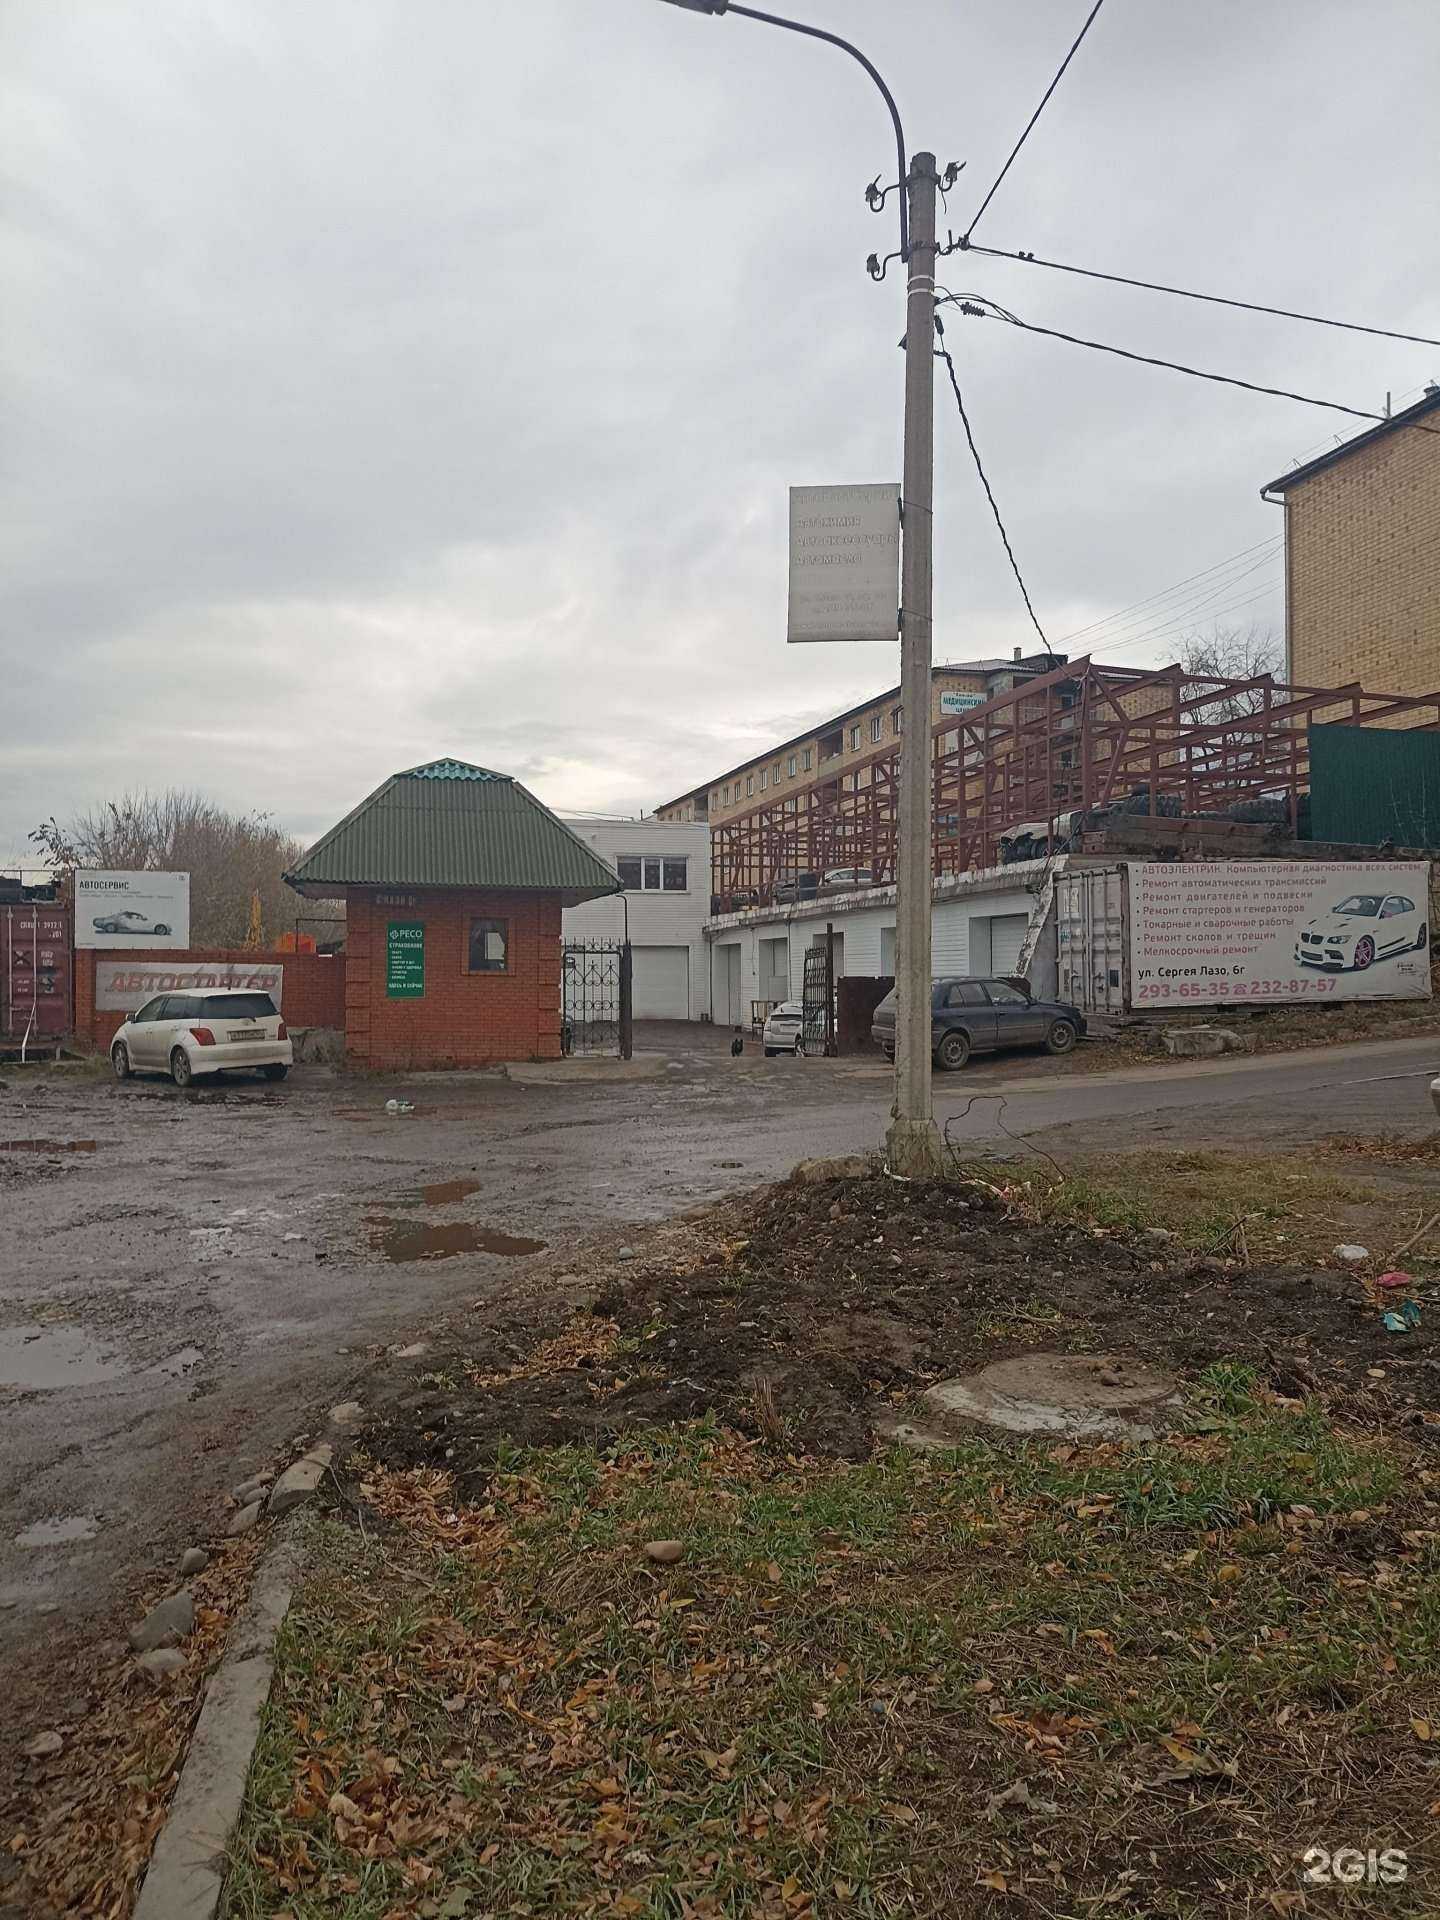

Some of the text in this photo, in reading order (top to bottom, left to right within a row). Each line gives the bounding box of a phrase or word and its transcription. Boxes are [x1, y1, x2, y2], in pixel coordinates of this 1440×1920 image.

[1226, 864, 1300, 875] Компьютерная
[1302, 863, 1363, 873] диагностика
[1365, 863, 1387, 872] всех
[79, 880, 129, 890] АВТОСЕРВИС
[1142, 876, 1327, 889] Ремонт автоматических трансмиссий
[1142, 891, 1313, 902] Ремонт двигателей и подвески
[1143, 906, 1179, 916] Ремонт
[1182, 905, 1232, 916] стартеров
[1243, 904, 1305, 914] генераторов
[1143, 917, 1294, 931] Токарные и сварочные работы
[399, 929, 423, 938] РЕСО
[1143, 931, 1277, 943] Ремонт сколов и трещин
[1143, 945, 1259, 957] Мелкосрочный ремонт
[1138, 964, 1246, 980] ул. Сергея Лазо, 6г
[111, 971, 277, 992] АВТОСТАРТЕР
[1138, 978, 1337, 998] 293-65-35 232-87-57
